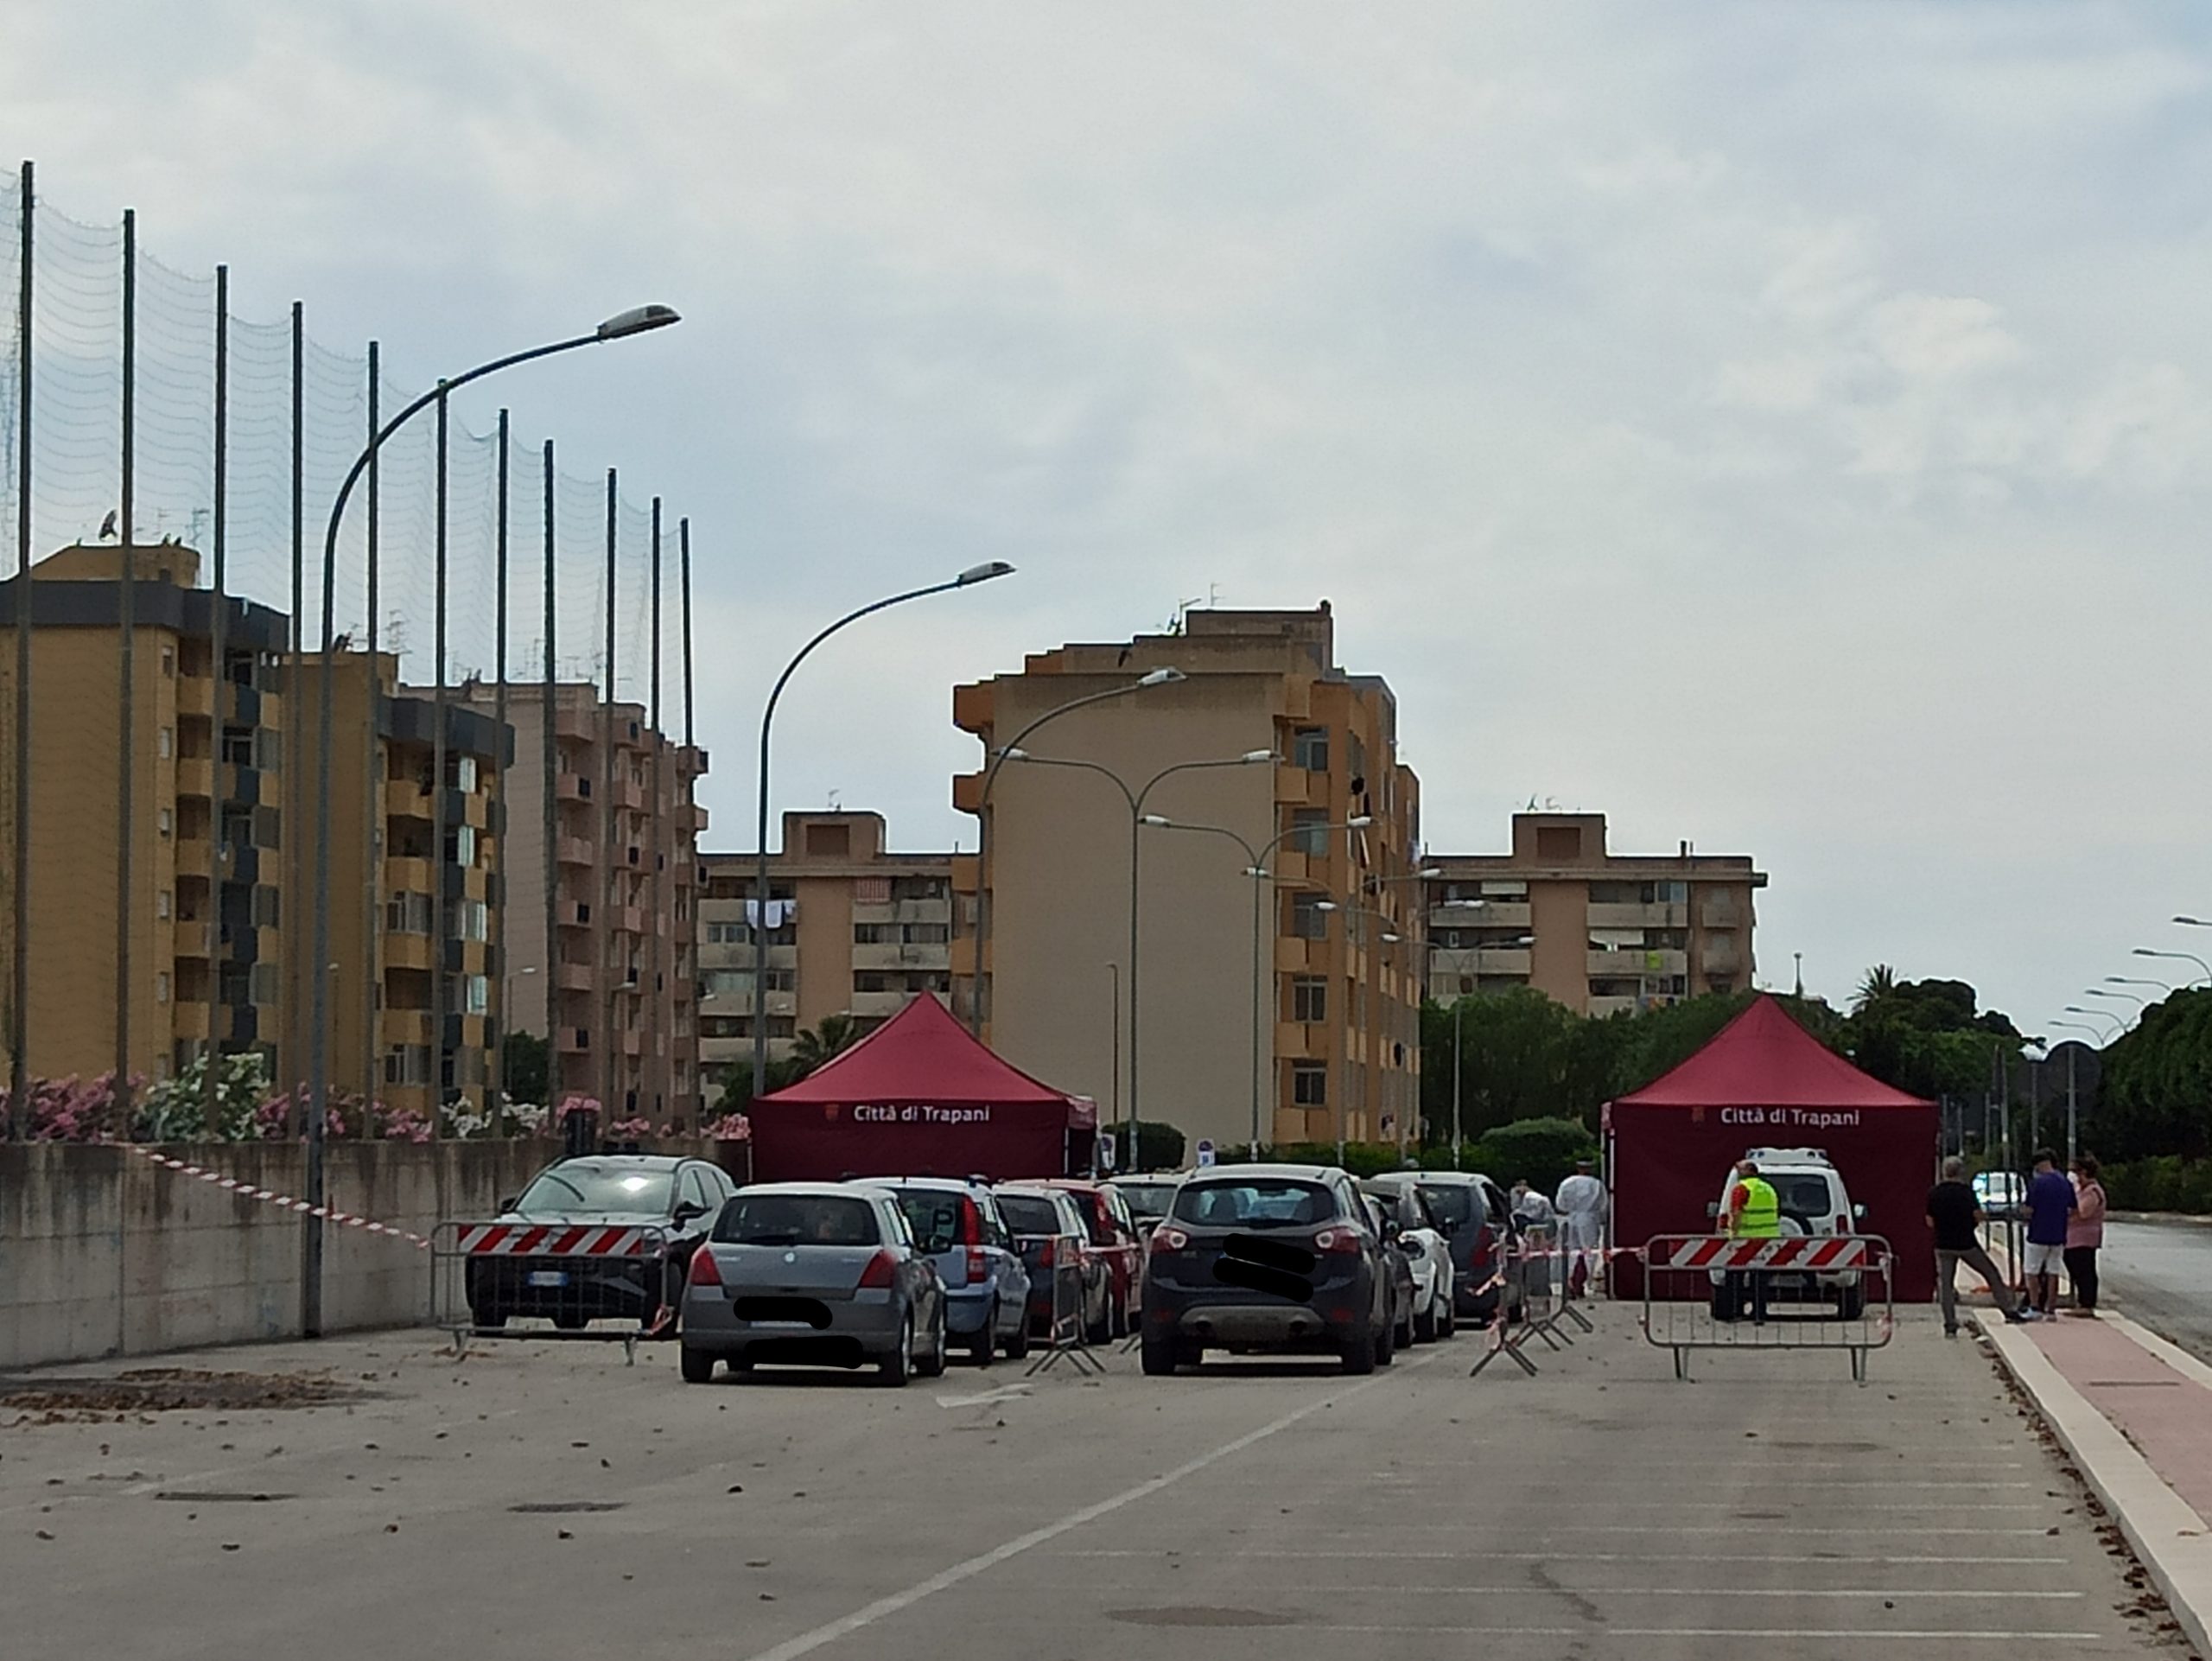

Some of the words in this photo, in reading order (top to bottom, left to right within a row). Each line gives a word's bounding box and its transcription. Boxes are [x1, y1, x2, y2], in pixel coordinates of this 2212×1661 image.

[854, 1105, 896, 1121] Città
[901, 1105, 918, 1121] di
[922, 1105, 989, 1124] Trapani
[1720, 1107, 1764, 1123] Città
[1770, 1108, 1785, 1124] di
[1791, 1109, 1859, 1129] Trapani
